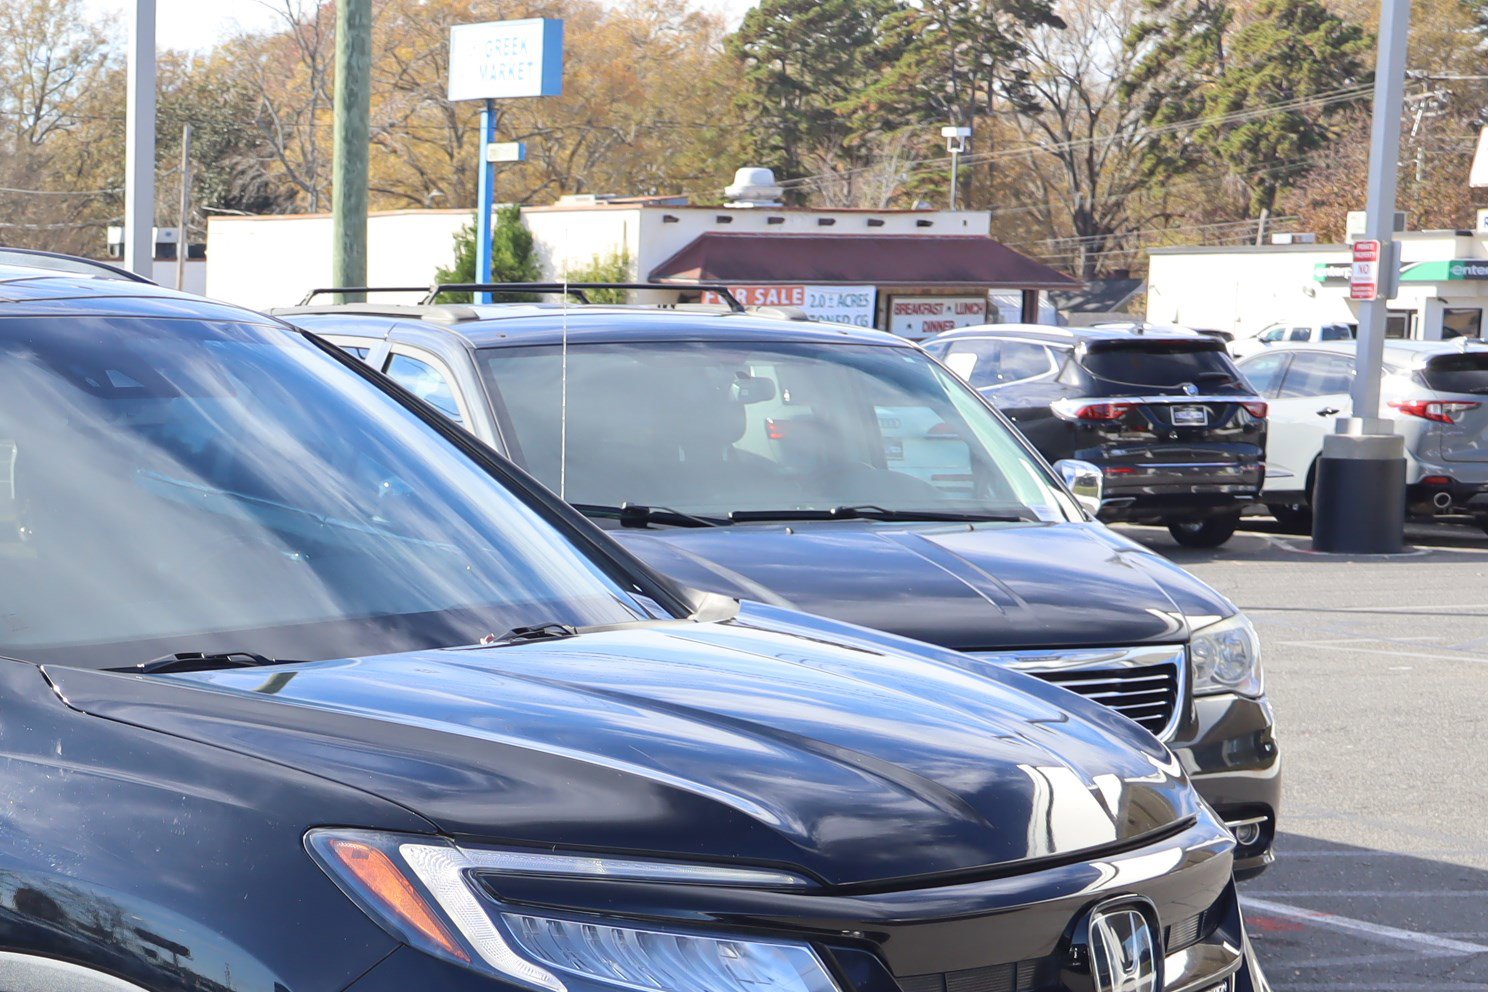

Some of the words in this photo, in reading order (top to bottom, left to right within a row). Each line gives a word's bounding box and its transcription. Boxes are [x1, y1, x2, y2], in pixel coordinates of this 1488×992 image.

[754, 288, 803, 304] SALE
[836, 293, 870, 308] ACRES
[894, 302, 944, 316] BREAKFAST
[954, 302, 985, 315] LUNCH
[922, 320, 955, 333] DINNER
